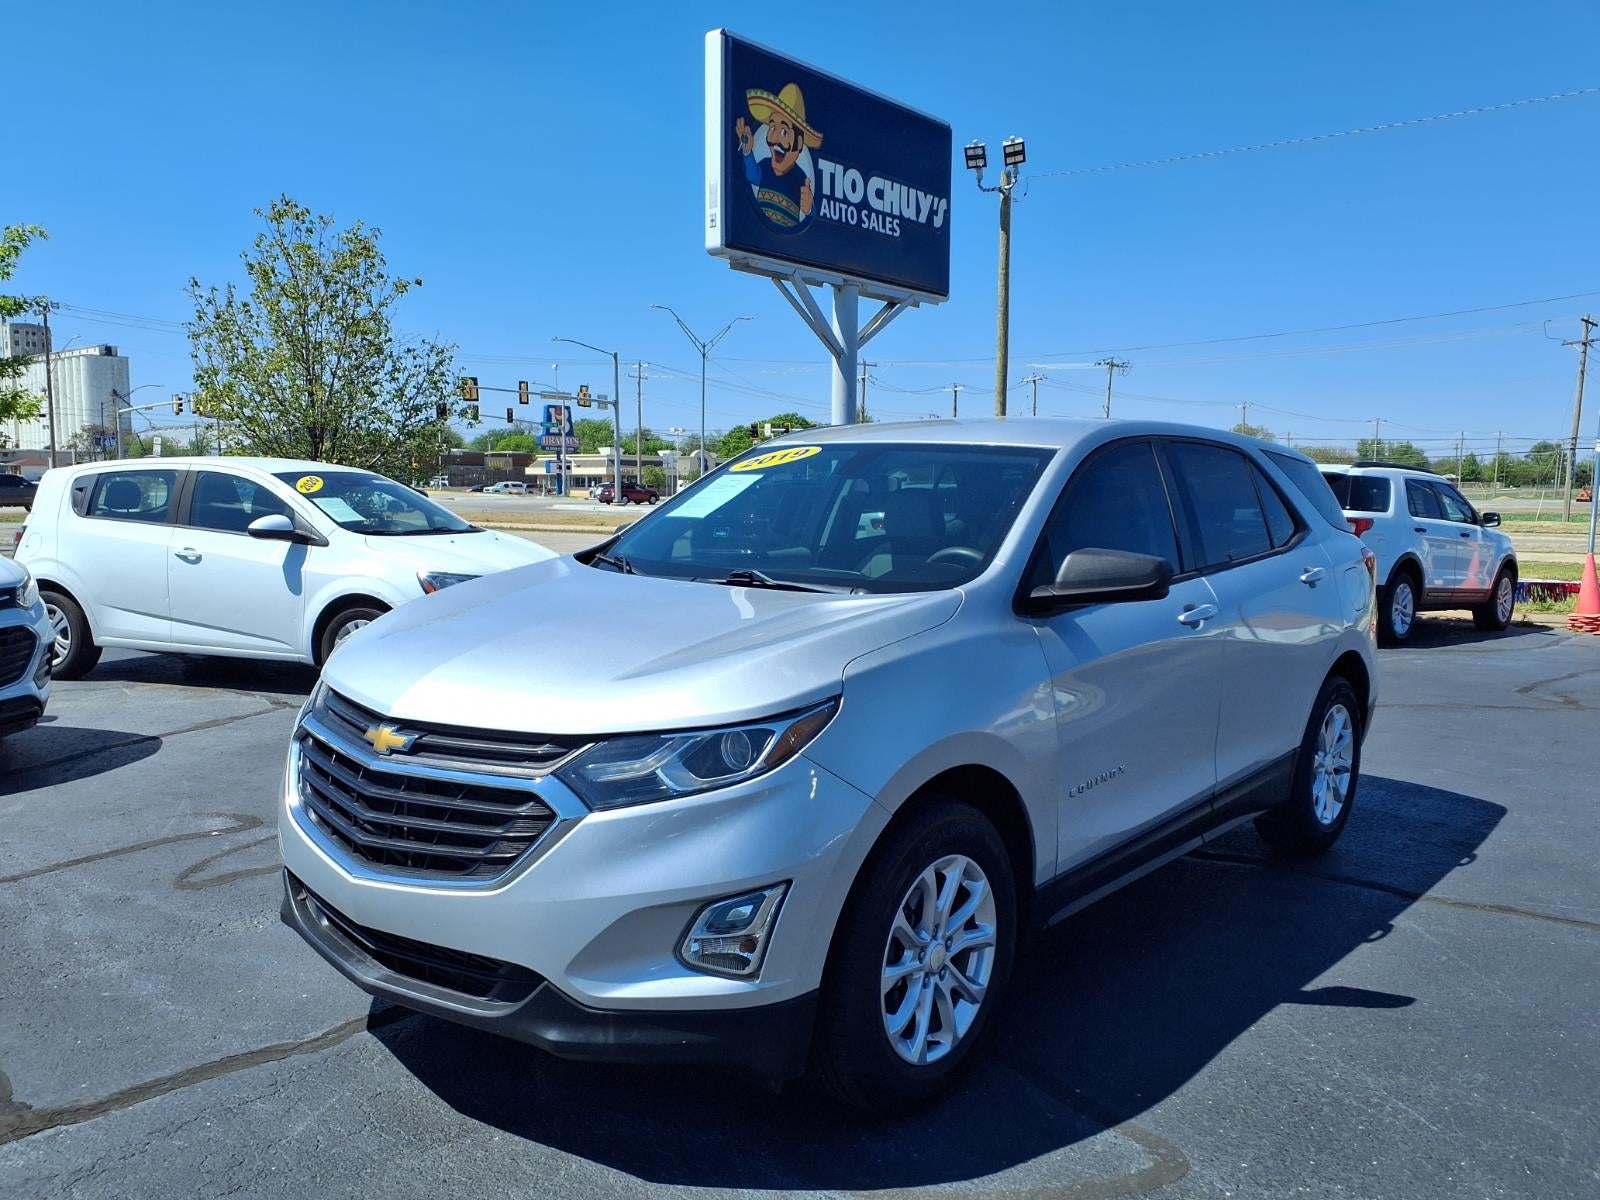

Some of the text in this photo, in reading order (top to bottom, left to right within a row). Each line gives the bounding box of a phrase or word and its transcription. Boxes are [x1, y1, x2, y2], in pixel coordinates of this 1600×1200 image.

[818, 157, 947, 228] TIO CHUY'S
[820, 198, 900, 237] AUTO SALES
[740, 449, 810, 469] 2019
[300, 477, 319, 491] 2020
